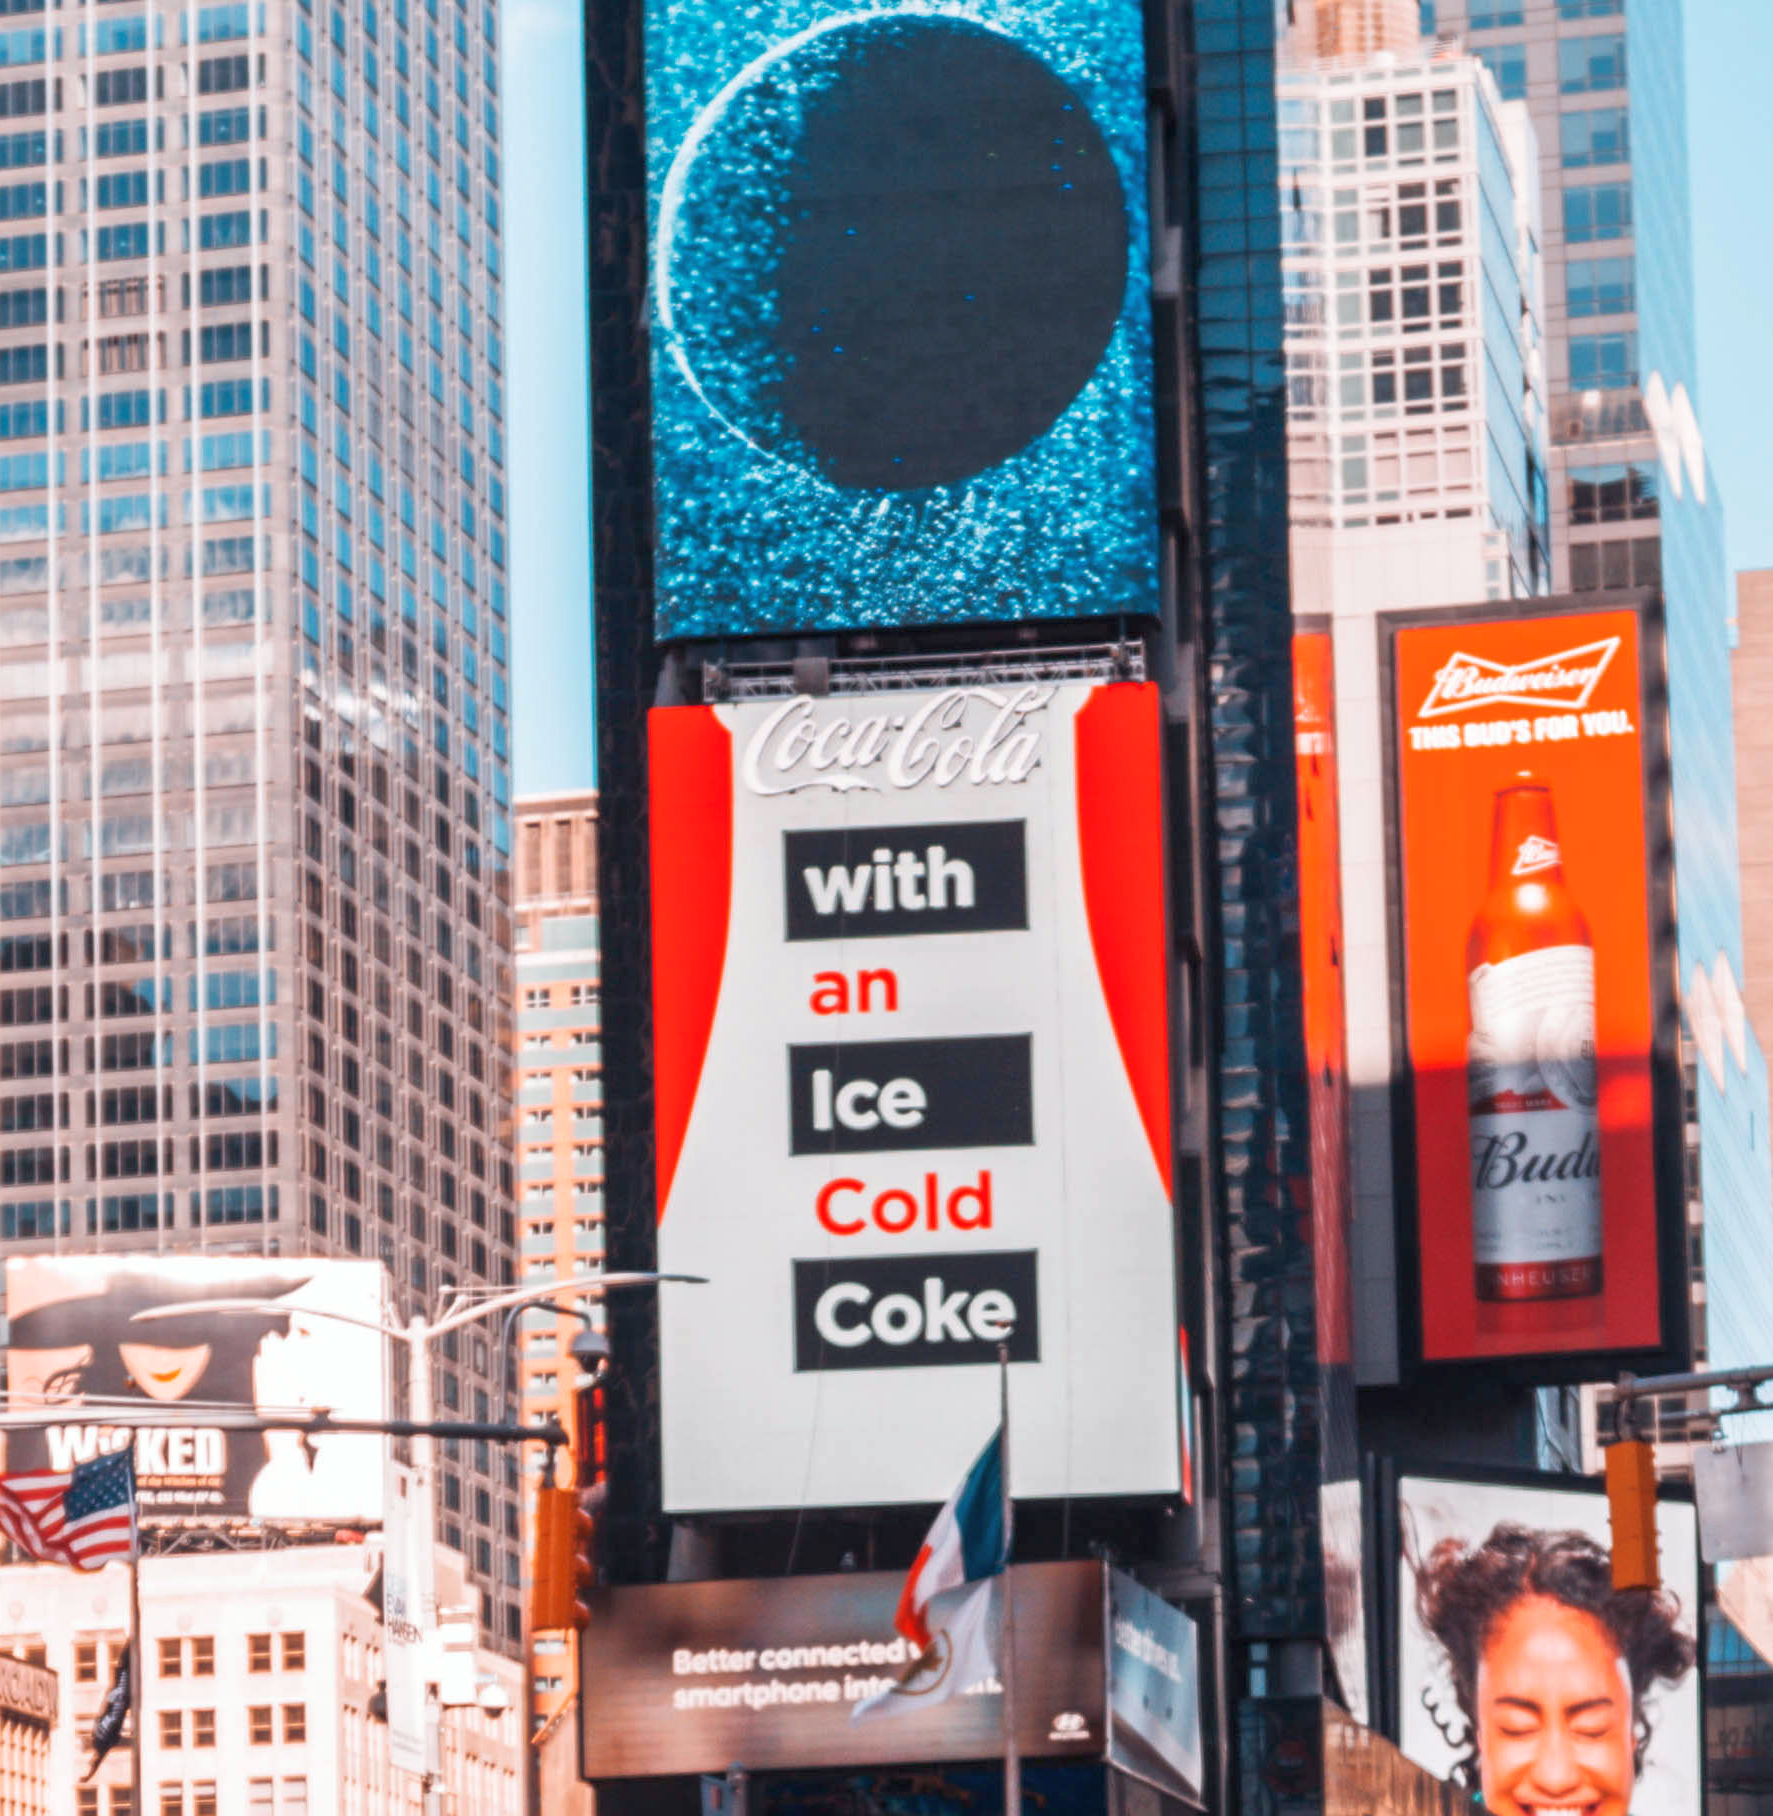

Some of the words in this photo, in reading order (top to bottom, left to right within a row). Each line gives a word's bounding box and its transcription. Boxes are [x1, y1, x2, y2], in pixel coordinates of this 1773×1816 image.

[1434, 663, 1598, 699] Budweiser
[743, 686, 1055, 796] Coca-Cola
[1408, 724, 1461, 750] THIS
[1464, 718, 1532, 748] BUD'S
[1534, 714, 1579, 742] FOR
[1581, 709, 1635, 737] YOU.
[803, 845, 976, 915] with
[808, 966, 900, 1017] an
[811, 1068, 928, 1132] Ice
[815, 1169, 994, 1237] Cold
[814, 1276, 1018, 1350] Coke
[672, 1647, 757, 1676] Better
[759, 1637, 907, 1669] connected
[672, 1678, 842, 1712] smartphone
